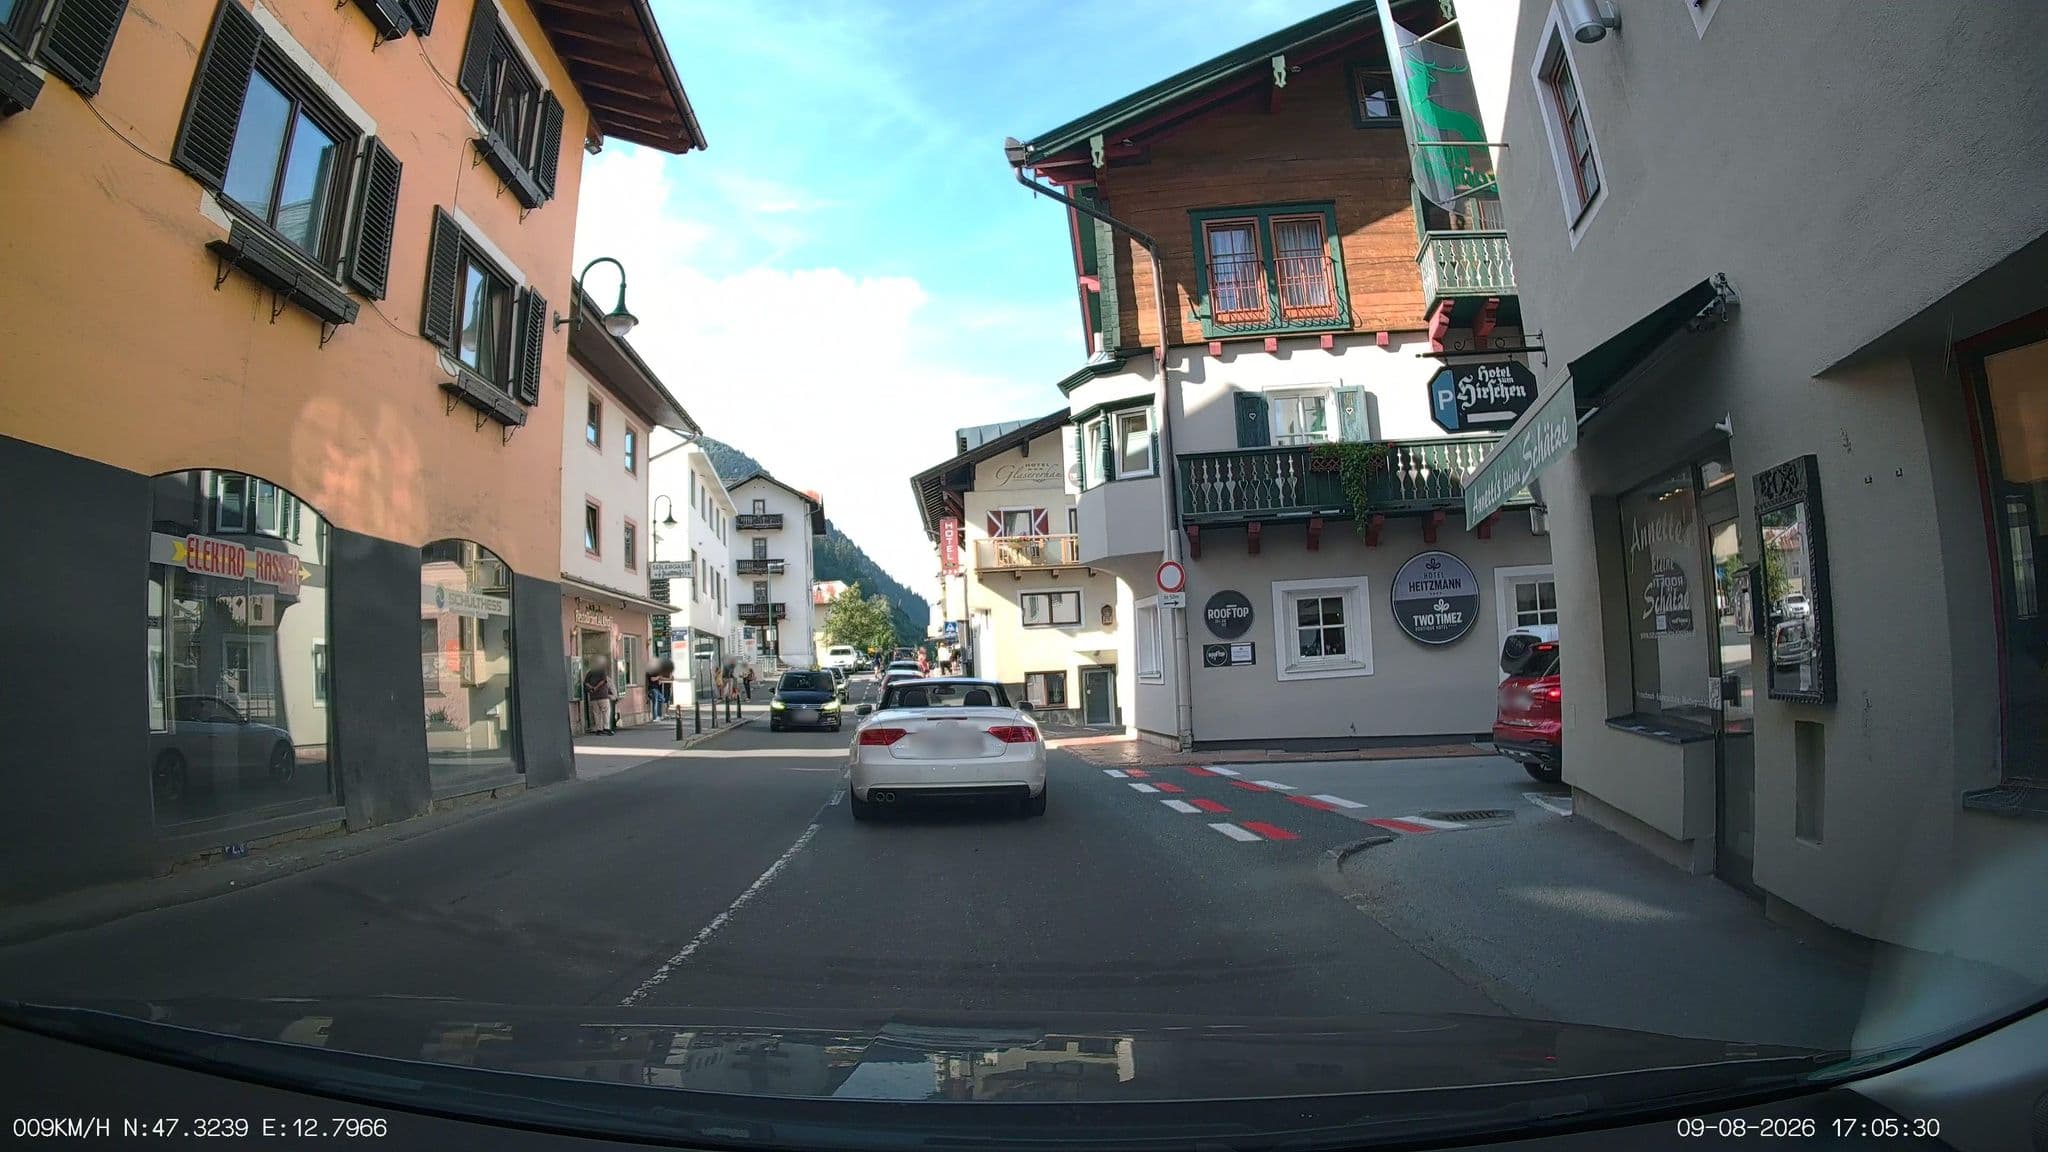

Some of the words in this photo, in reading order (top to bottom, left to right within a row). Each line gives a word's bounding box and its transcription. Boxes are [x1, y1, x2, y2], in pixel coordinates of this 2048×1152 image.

[1478, 365, 1512, 383] Hotel
[1498, 377, 1514, 385] zum
[1438, 390, 1454, 411] P
[1521, 416, 1569, 486] Schätze
[944, 523, 954, 560] HOTEL
[186, 536, 245, 578] ELEKTRO
[1423, 571, 1444, 579] HOTEL
[1408, 578, 1462, 593] HEITZMANN
[1207, 607, 1249, 620] ROOFTOP
[1413, 614, 1434, 627] TWO
[1435, 611, 1463, 625] TIMEZ
